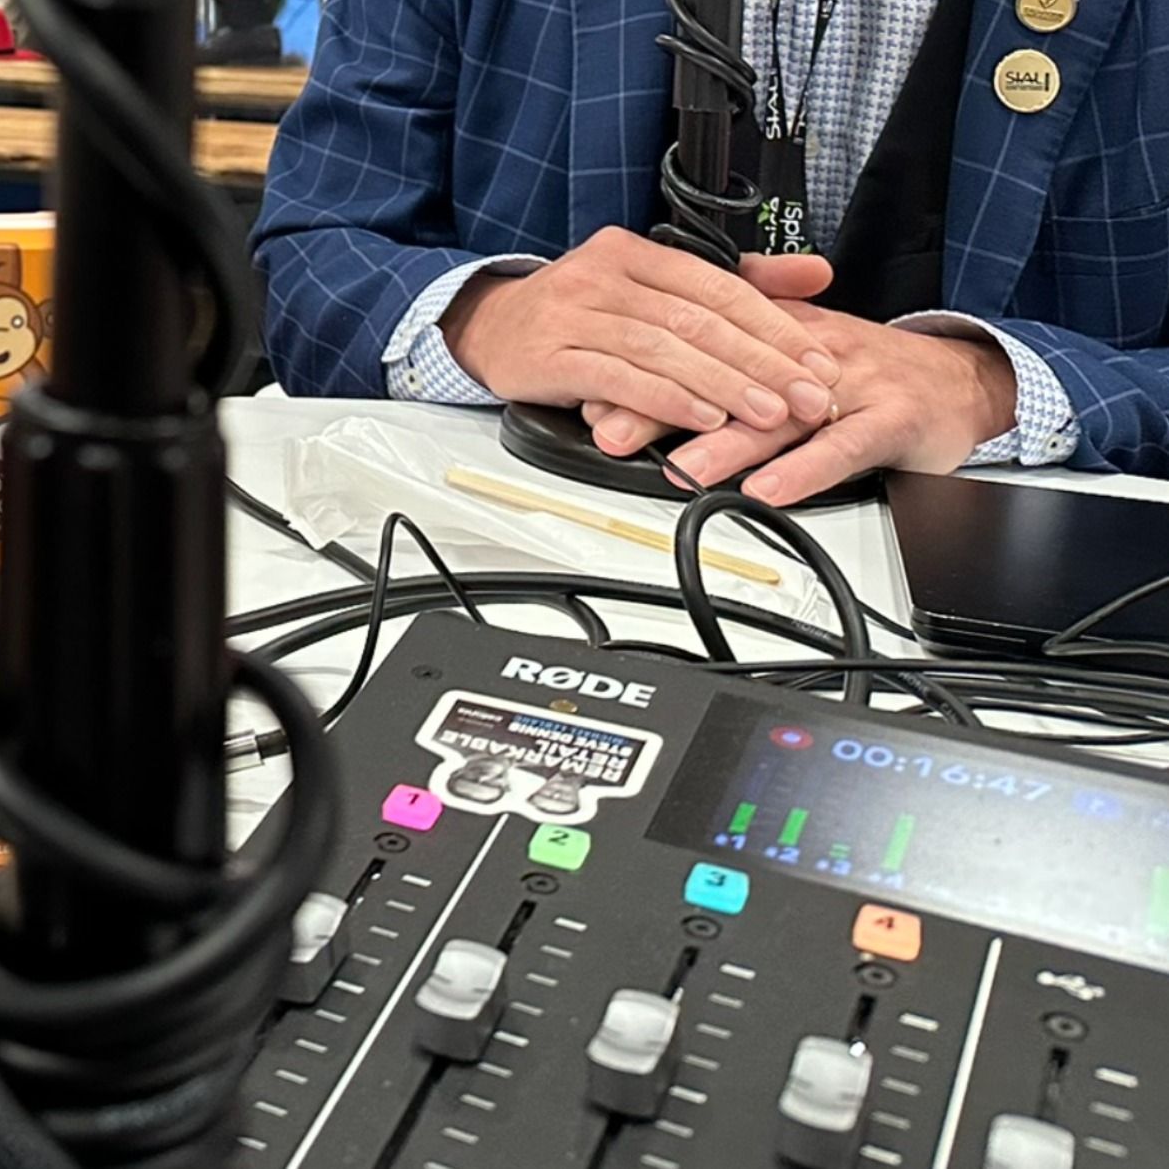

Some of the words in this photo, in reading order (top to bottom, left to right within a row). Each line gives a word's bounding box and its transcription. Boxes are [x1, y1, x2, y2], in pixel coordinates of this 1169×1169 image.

[779, 201, 805, 254] iSpic
[500, 656, 658, 709] RØDE
[439, 729, 623, 783] REMARKABLE
[535, 739, 629, 769] RETAIL
[832, 739, 1053, 801] 00:16:47
[407, 792, 420, 806] 1
[547, 830, 570, 846] 2
[707, 871, 727, 887] 3
